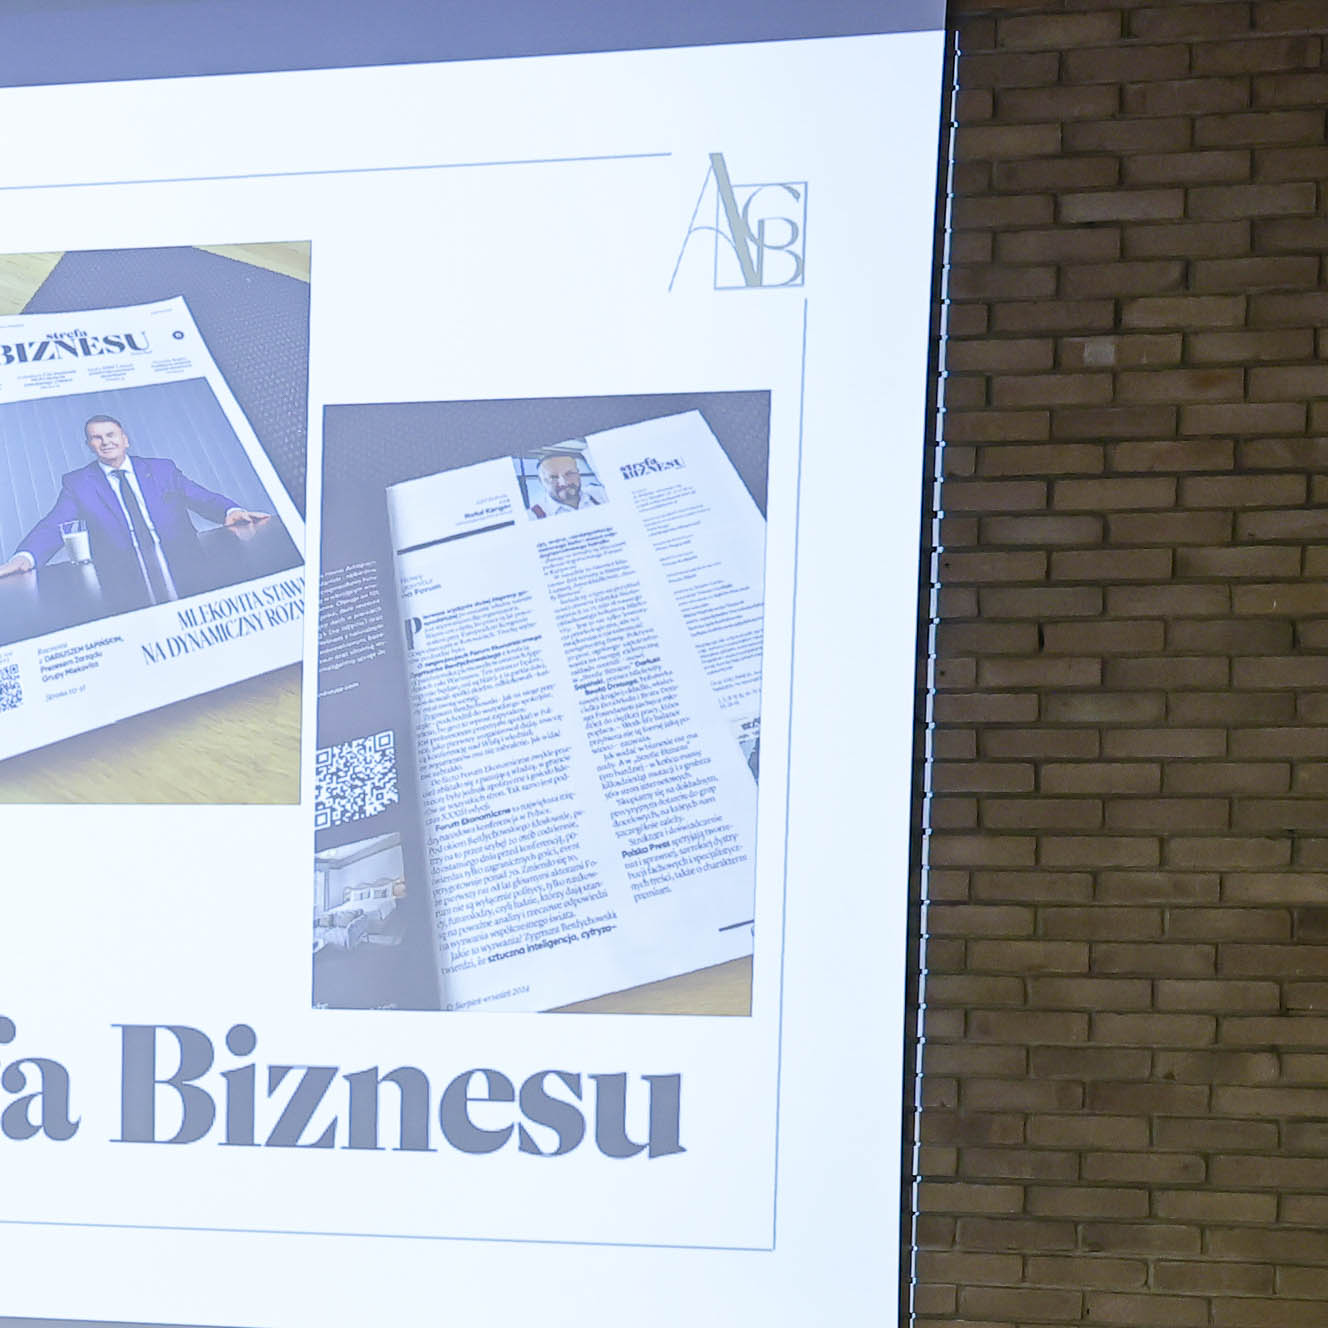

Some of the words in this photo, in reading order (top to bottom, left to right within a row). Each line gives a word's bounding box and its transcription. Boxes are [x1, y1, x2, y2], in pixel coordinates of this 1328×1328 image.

[177, 591, 266, 631] MLEKOVITA
[142, 643, 167, 665] NA
[170, 612, 264, 655] DYNAMICZNY
[110, 1023, 688, 1160] Biznesu
